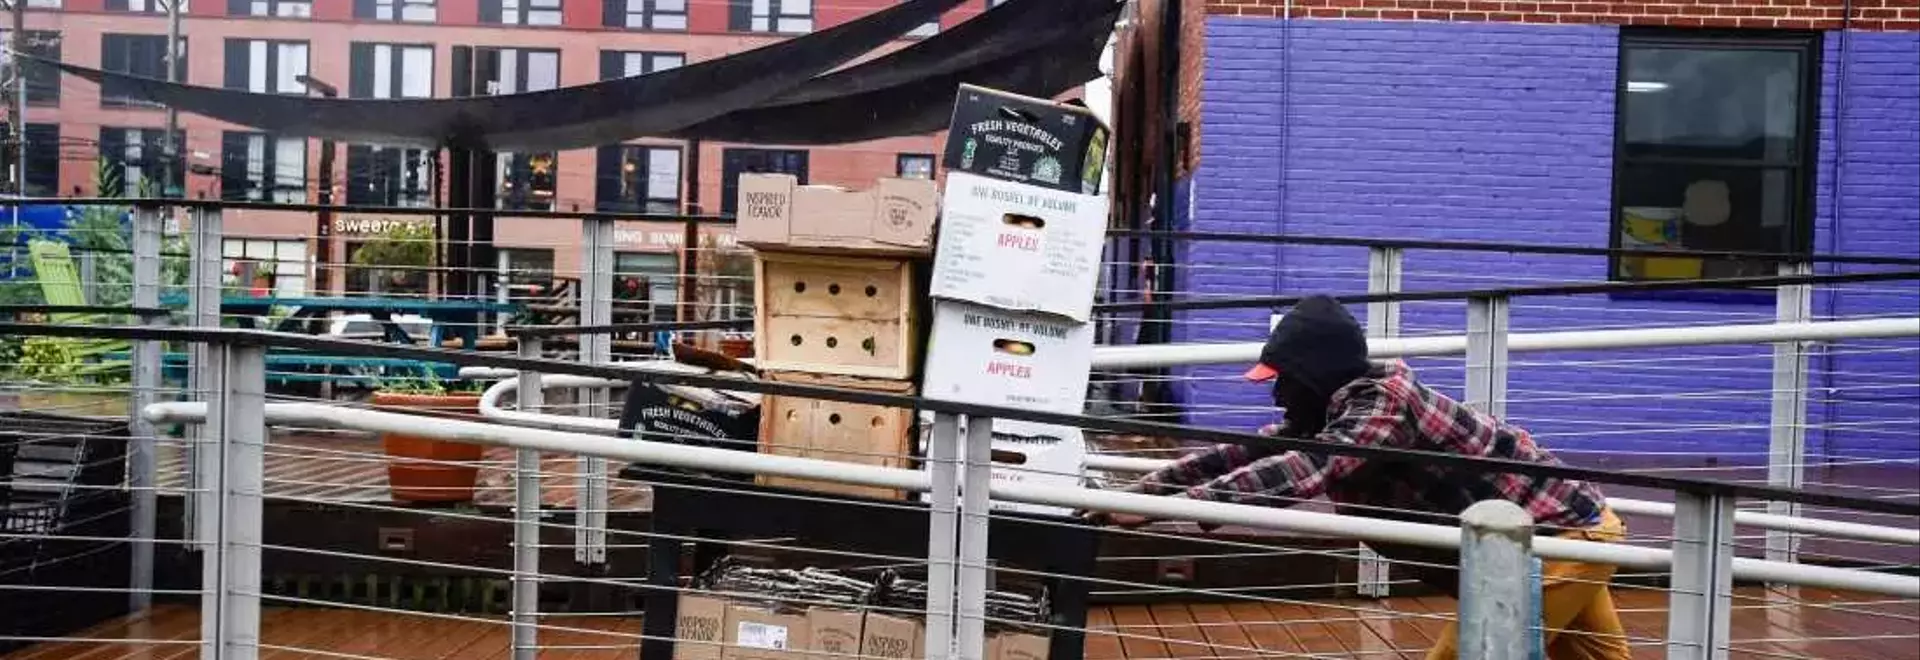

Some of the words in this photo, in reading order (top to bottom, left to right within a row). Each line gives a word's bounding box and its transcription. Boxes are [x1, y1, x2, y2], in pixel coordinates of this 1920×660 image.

[971, 120, 1002, 135] FRESH
[1005, 121, 1063, 151] VEGETABLES
[997, 233, 1039, 252] APPLES
[987, 361, 1033, 378] APPLES
[641, 406, 671, 420] FRESH
[672, 409, 727, 438] VEGETABLES
